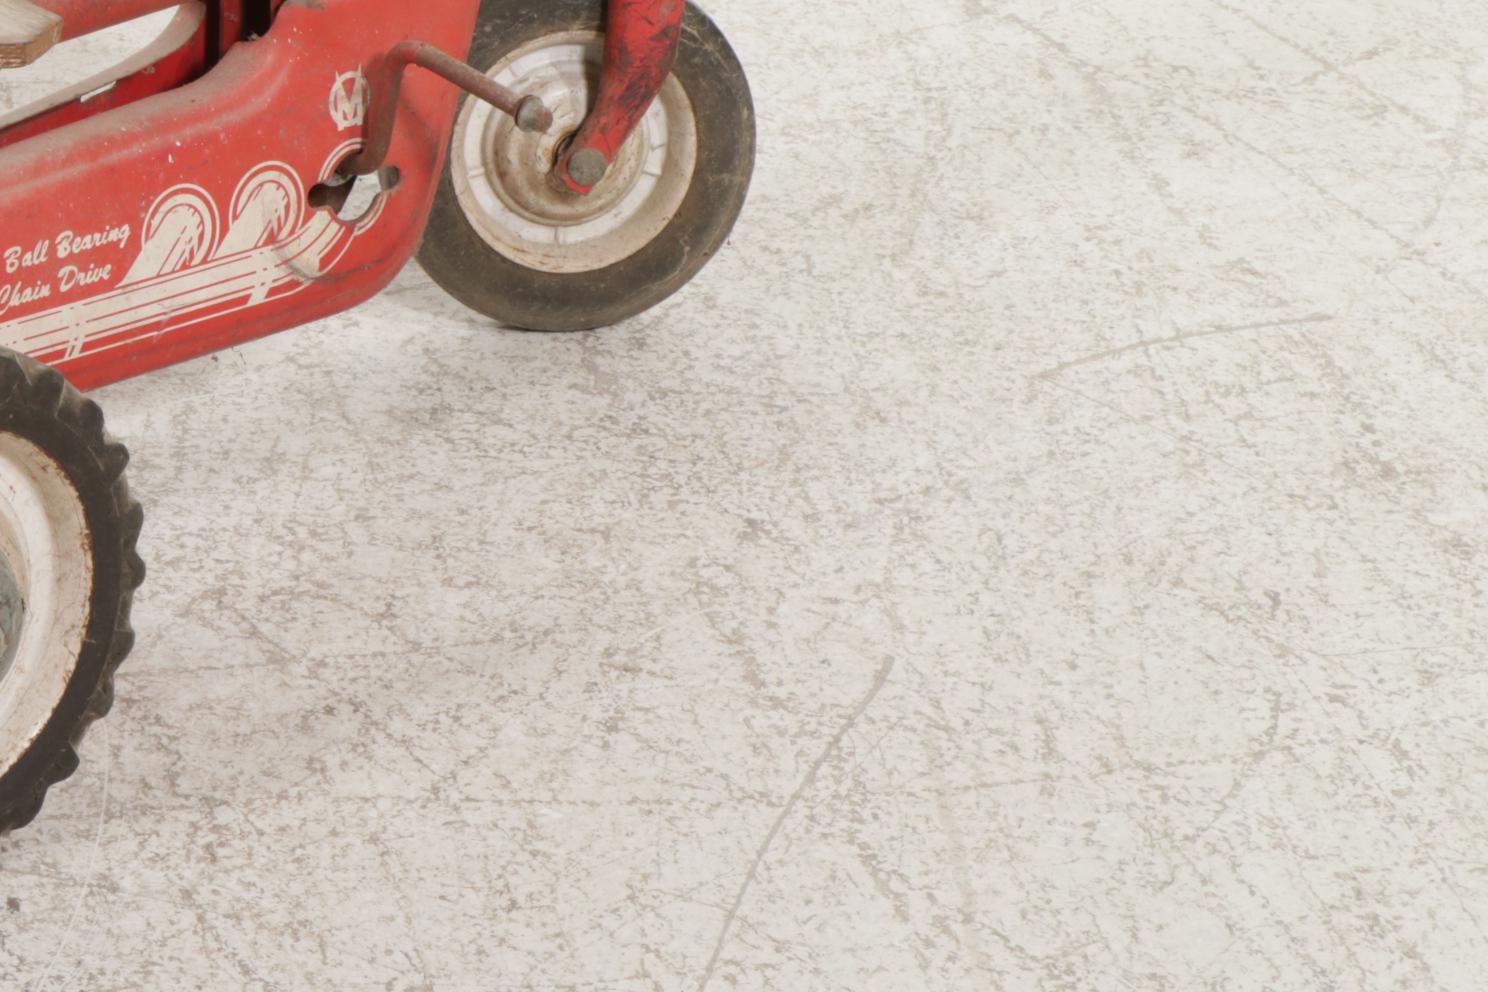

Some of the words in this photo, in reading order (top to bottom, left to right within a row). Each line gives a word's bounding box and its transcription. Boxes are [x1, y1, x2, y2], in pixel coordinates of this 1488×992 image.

[3, 239, 49, 274] Ball
[55, 224, 130, 258] Bearing
[57, 263, 111, 292] Drive
